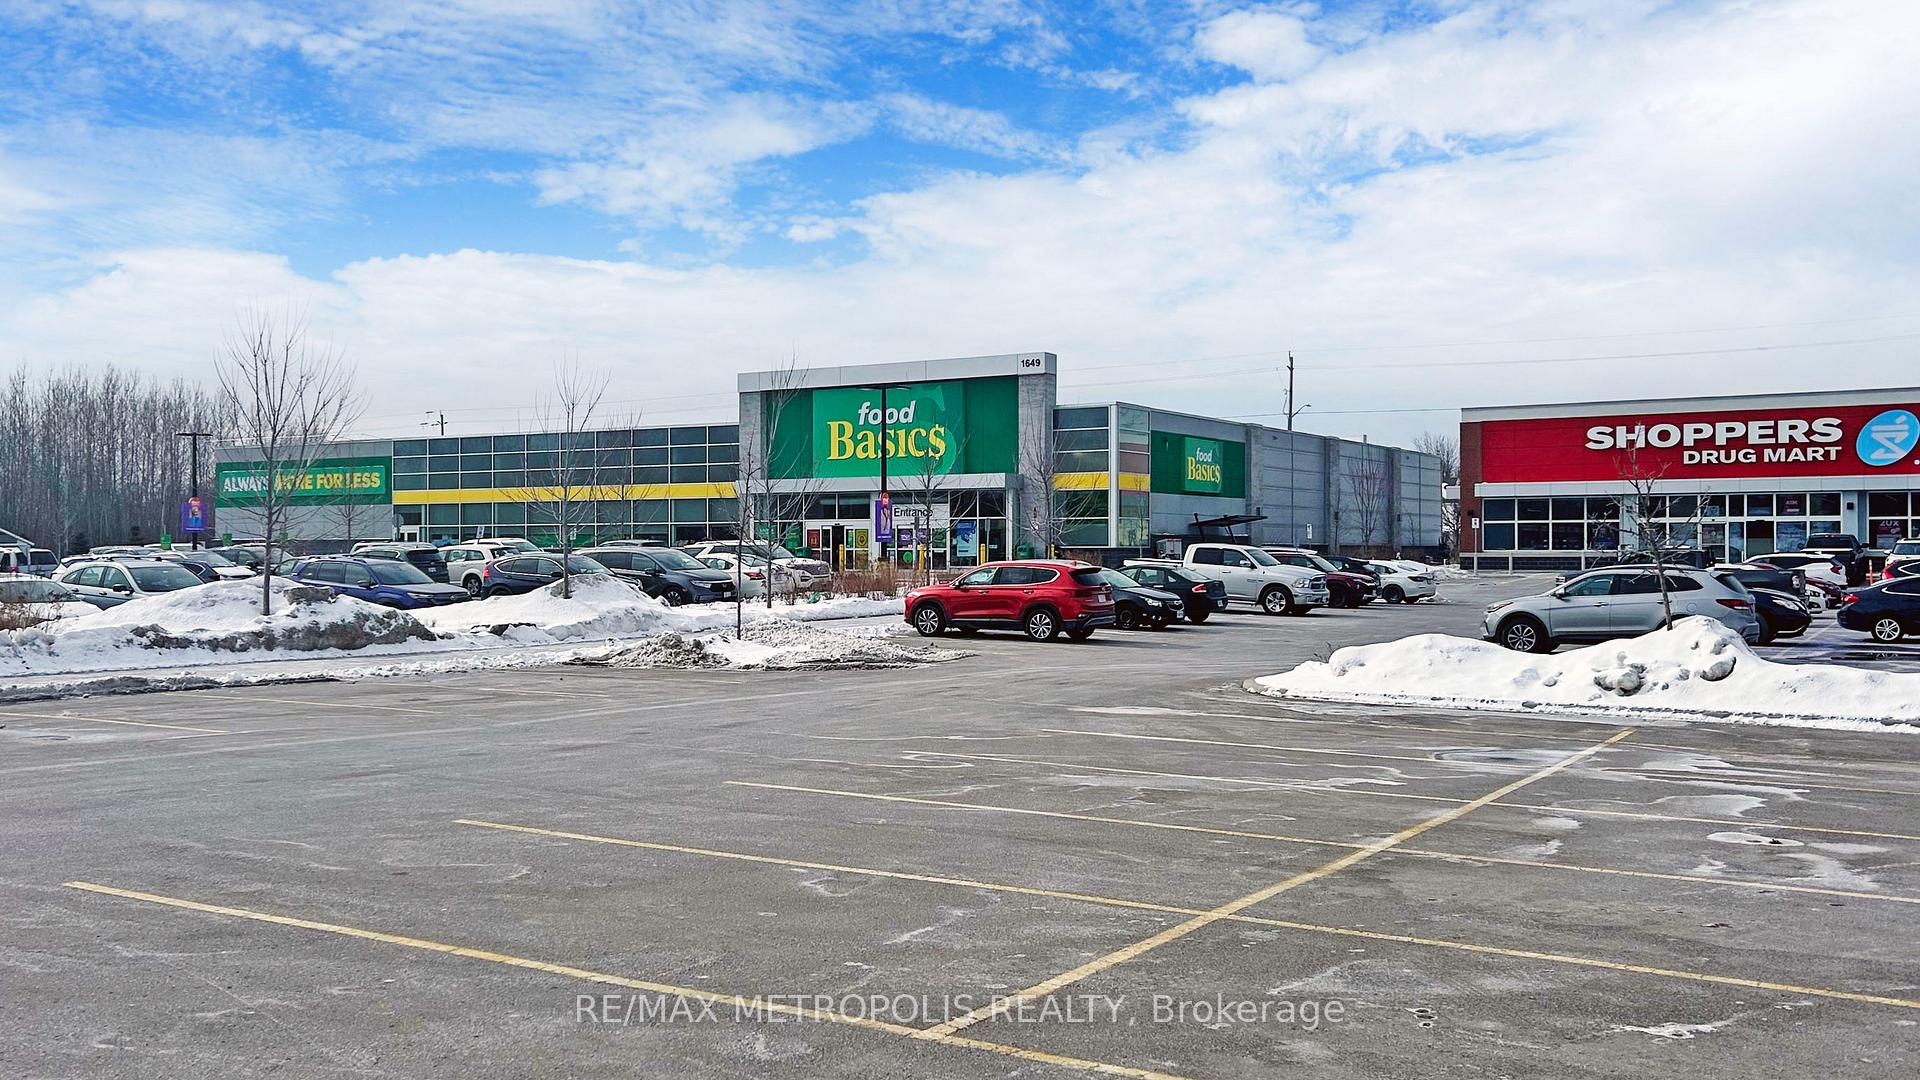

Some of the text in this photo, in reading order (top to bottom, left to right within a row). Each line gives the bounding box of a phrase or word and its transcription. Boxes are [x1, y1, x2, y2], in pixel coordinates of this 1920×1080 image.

[1021, 358, 1041, 368] 1649
[858, 400, 916, 426] food
[1585, 417, 1843, 450] SHOPPERS
[1196, 447, 1213, 463] food
[1683, 446, 1842, 465] DRUG MART
[316, 473, 343, 489] FOR
[345, 472, 381, 489] LESS
